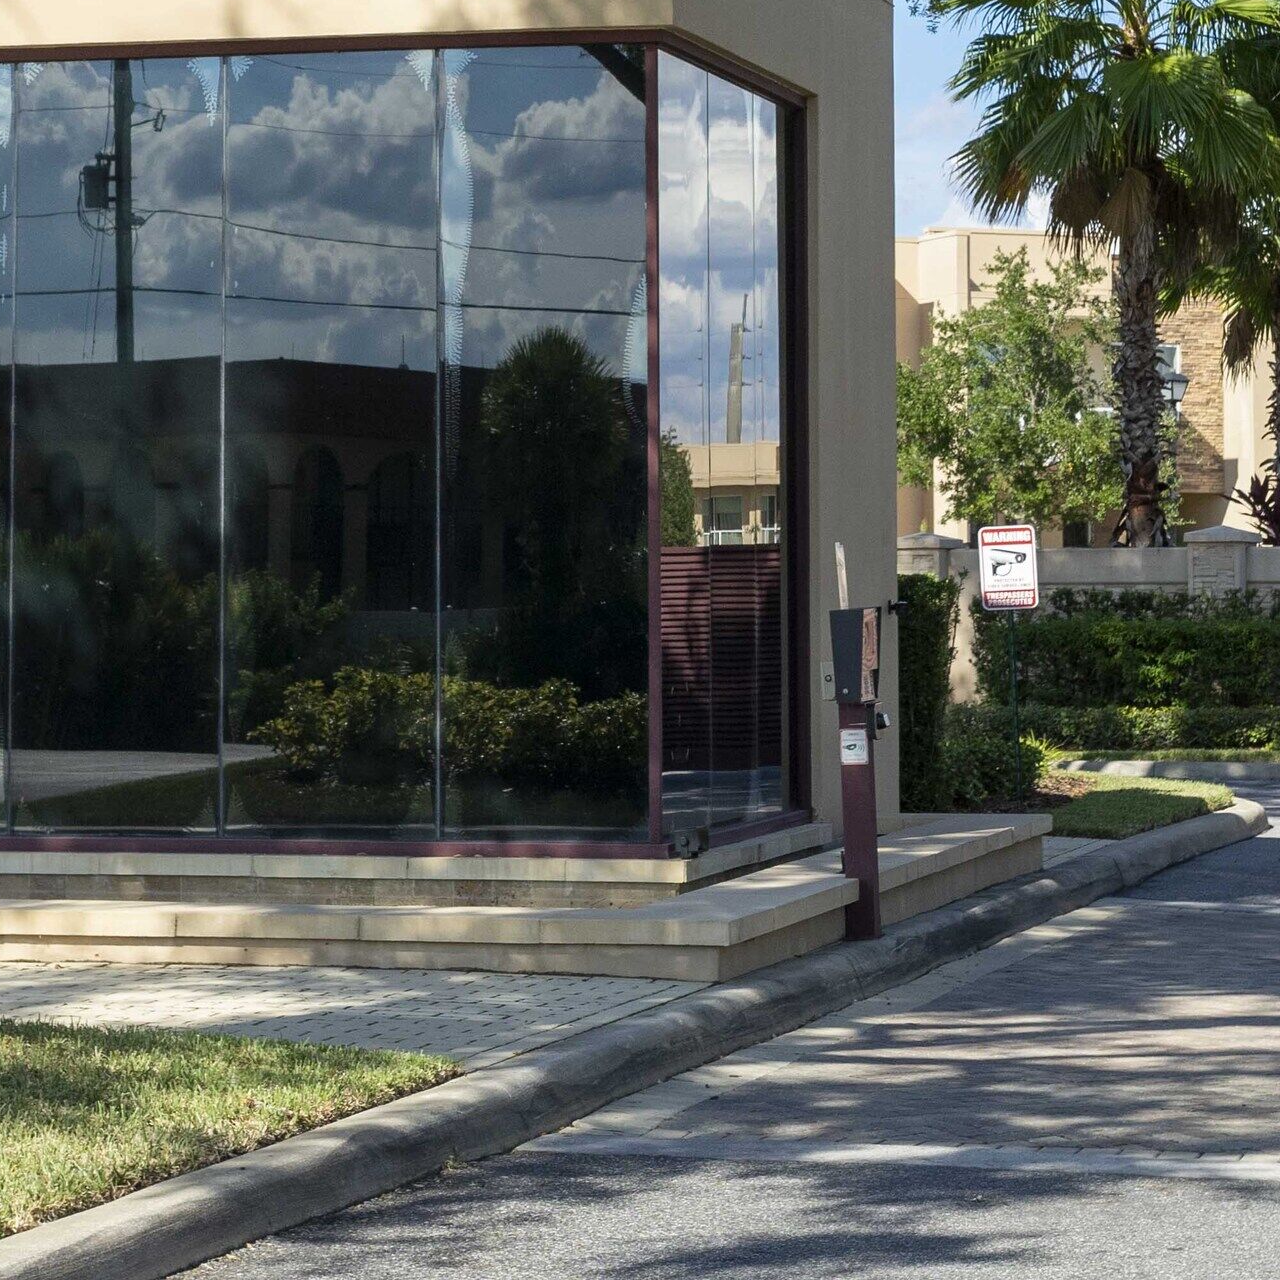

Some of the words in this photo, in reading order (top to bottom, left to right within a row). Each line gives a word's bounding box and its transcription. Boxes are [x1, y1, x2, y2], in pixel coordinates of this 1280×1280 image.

[983, 531, 1031, 543] WARNING
[986, 591, 1034, 600] TRESPASSERS
[988, 597, 1033, 606] PROSECUTED
